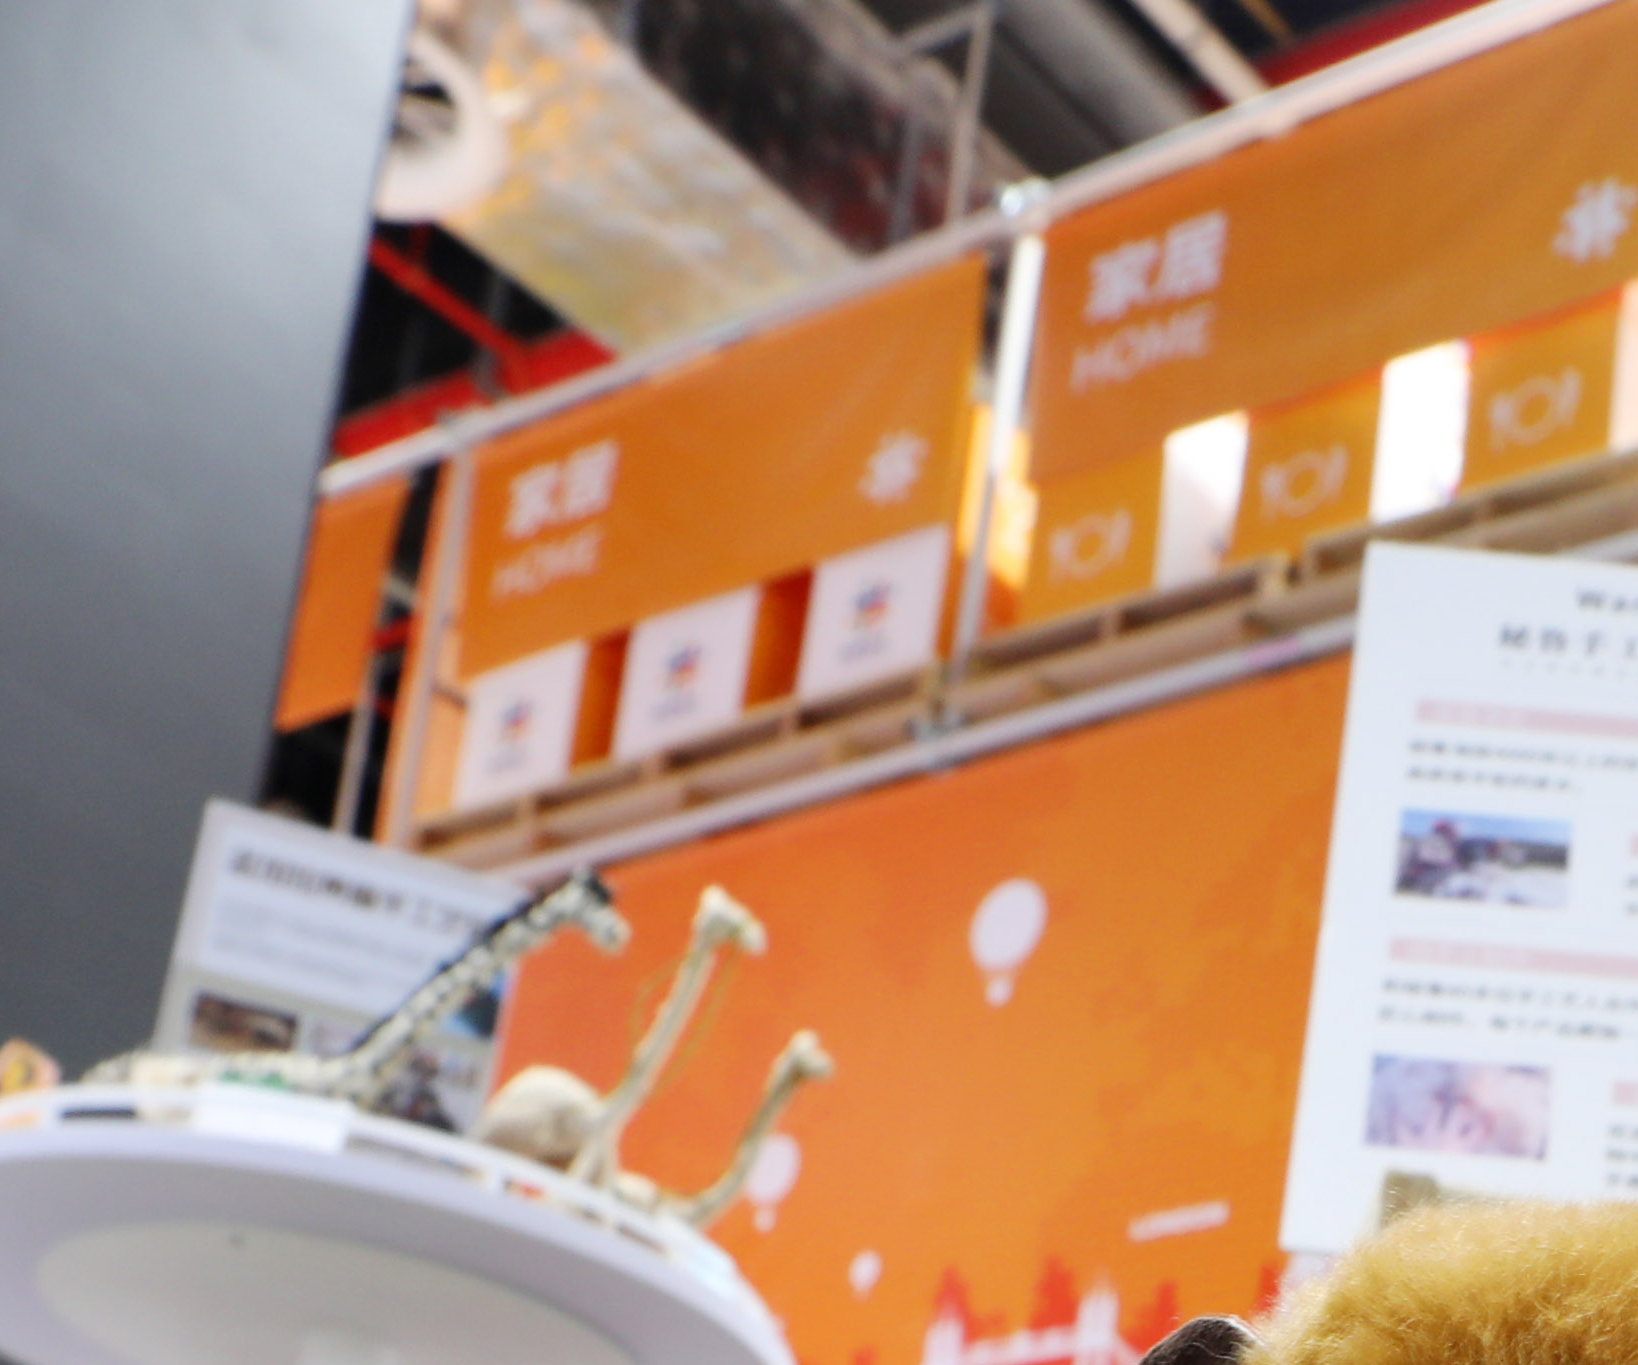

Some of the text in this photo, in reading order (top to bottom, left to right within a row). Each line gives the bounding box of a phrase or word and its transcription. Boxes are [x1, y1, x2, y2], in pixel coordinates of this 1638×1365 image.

[1082, 209, 1230, 326] 家居
[1068, 302, 1215, 396] HOME
[502, 438, 622, 540] 家居
